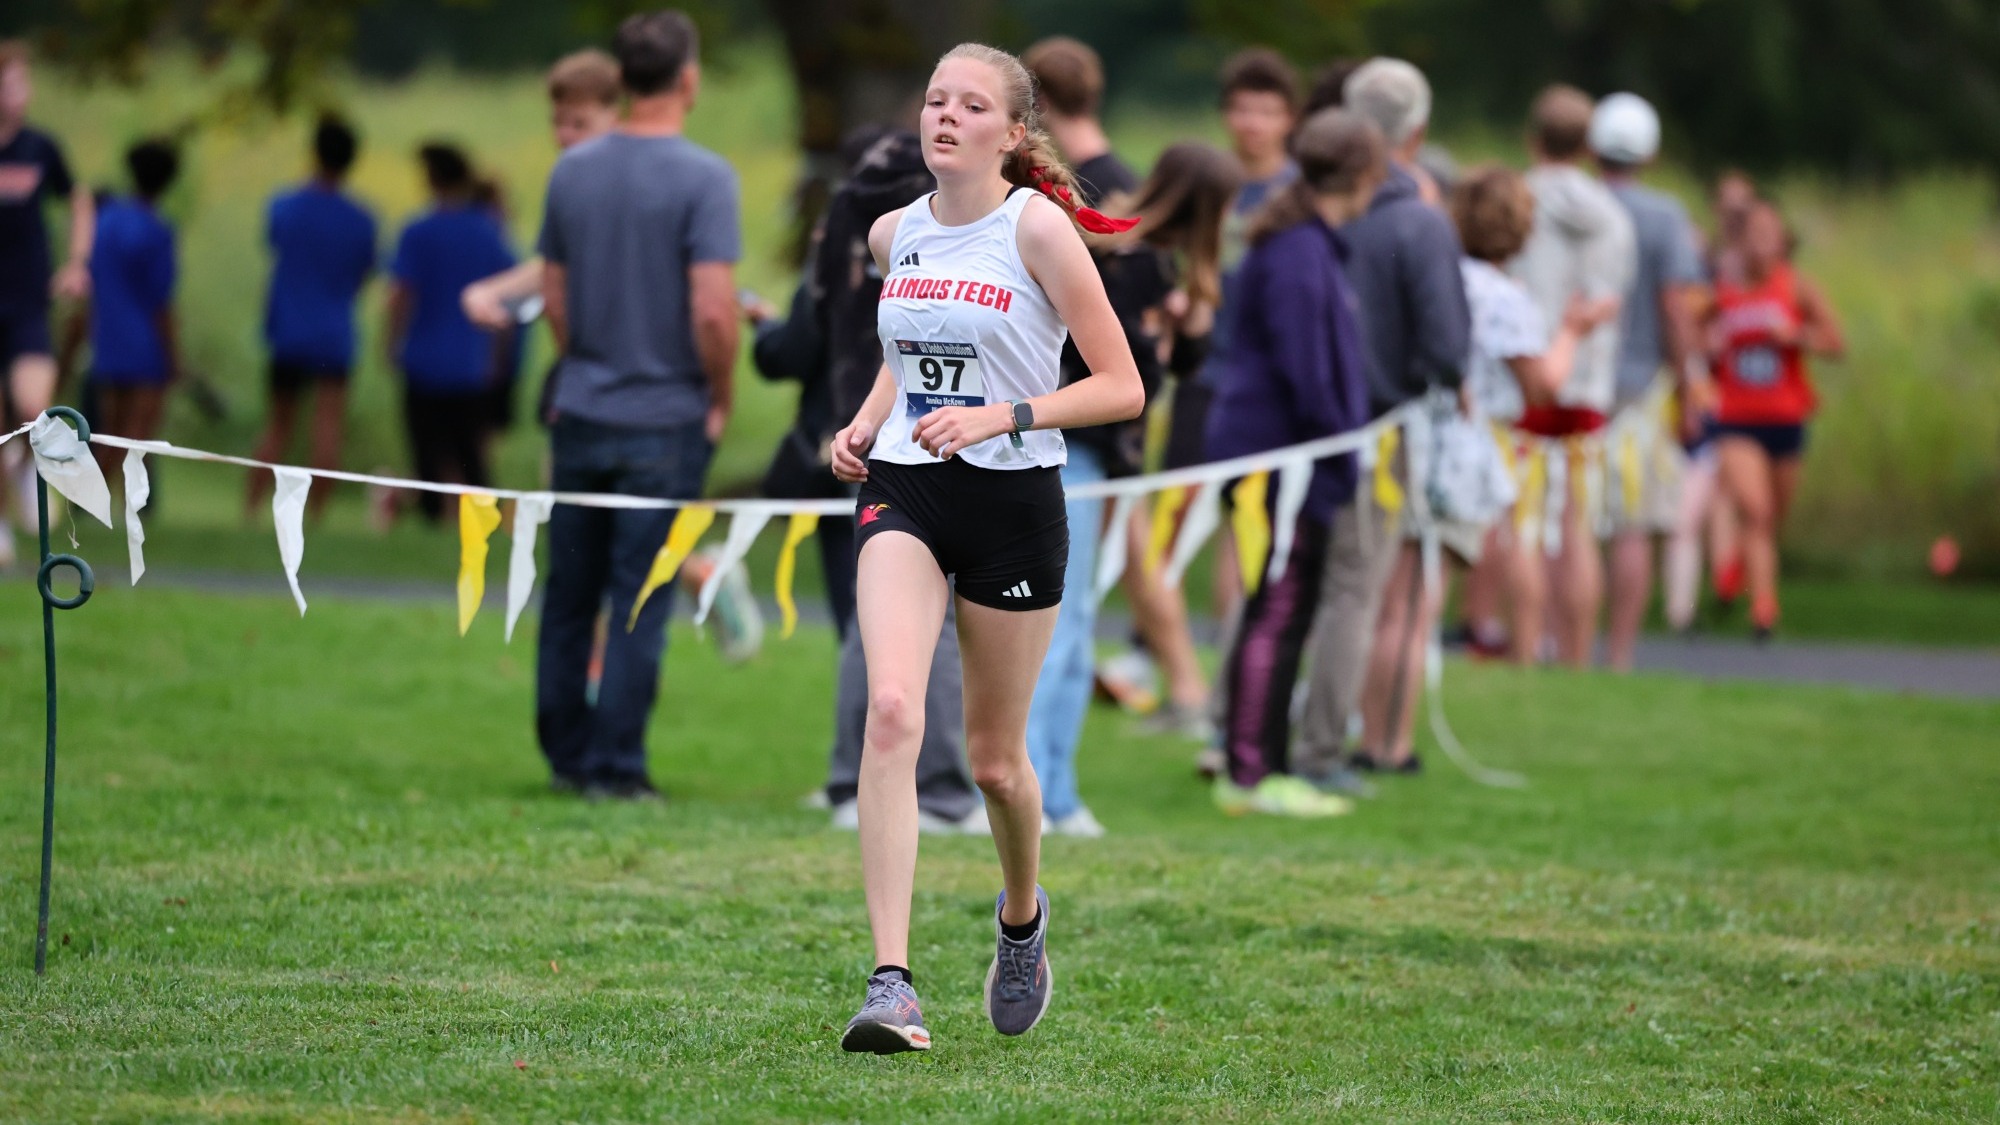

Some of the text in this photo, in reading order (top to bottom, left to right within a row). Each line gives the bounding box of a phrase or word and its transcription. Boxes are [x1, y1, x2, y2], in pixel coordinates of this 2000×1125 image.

[880, 278, 1012, 313] LLINOIS TECH
[919, 357, 966, 392] 97
